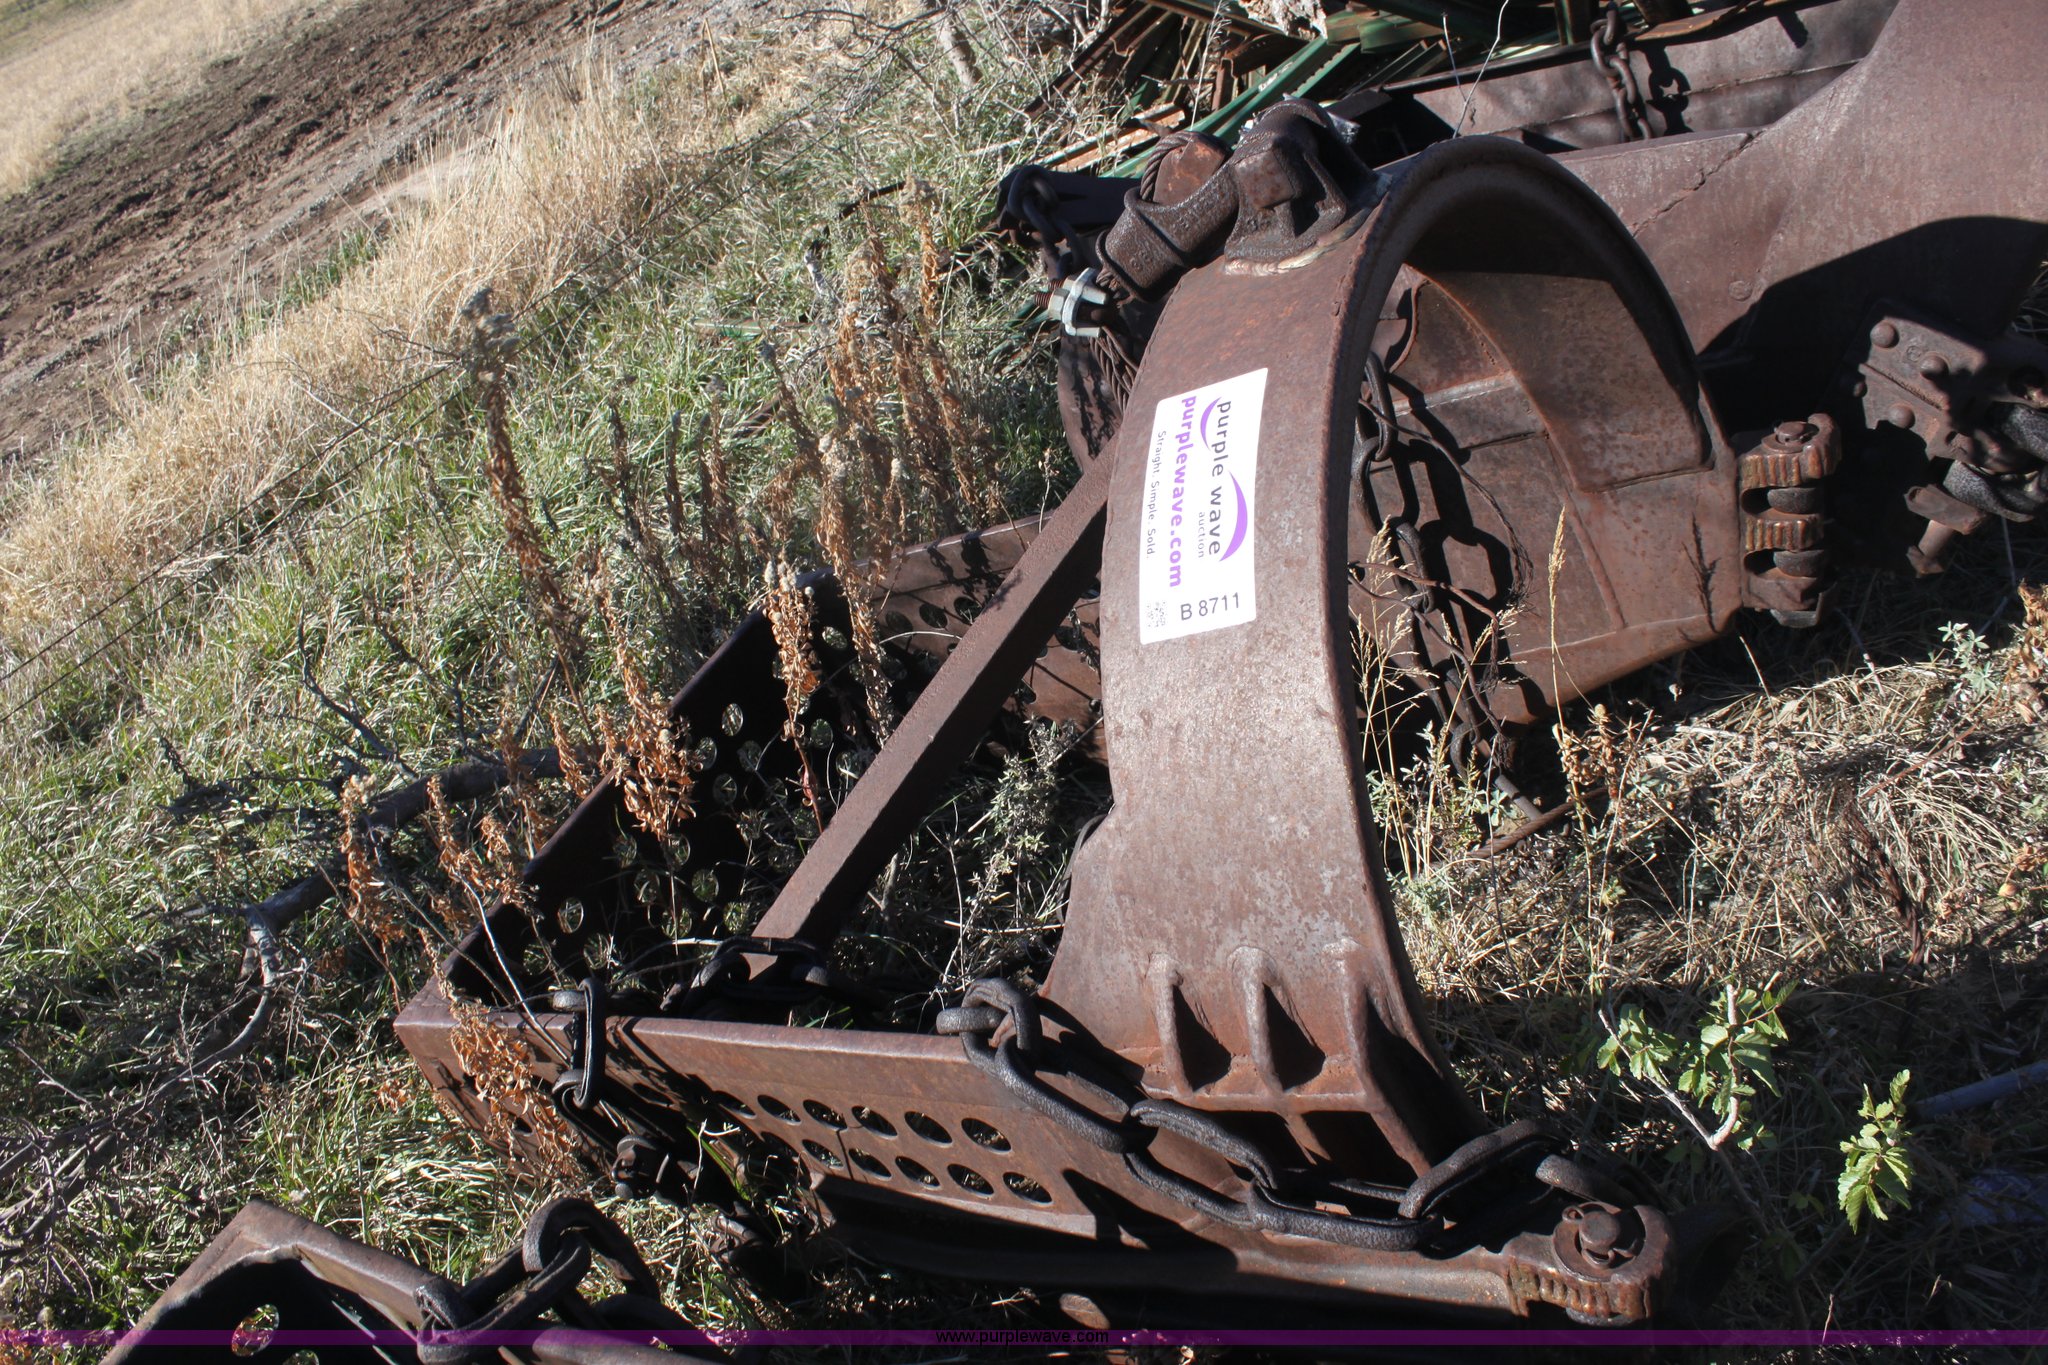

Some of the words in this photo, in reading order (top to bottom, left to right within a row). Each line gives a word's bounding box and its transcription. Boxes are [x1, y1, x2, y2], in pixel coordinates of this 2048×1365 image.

[1151, 430, 1167, 478] Straight.
[1211, 400, 1232, 477] purple
[1169, 395, 1197, 587] purplewave.com
[1146, 528, 1157, 559] Sold.
[1208, 486, 1222, 555] wave
[1180, 602, 1193, 621] B
[1198, 592, 1240, 617] 8711
